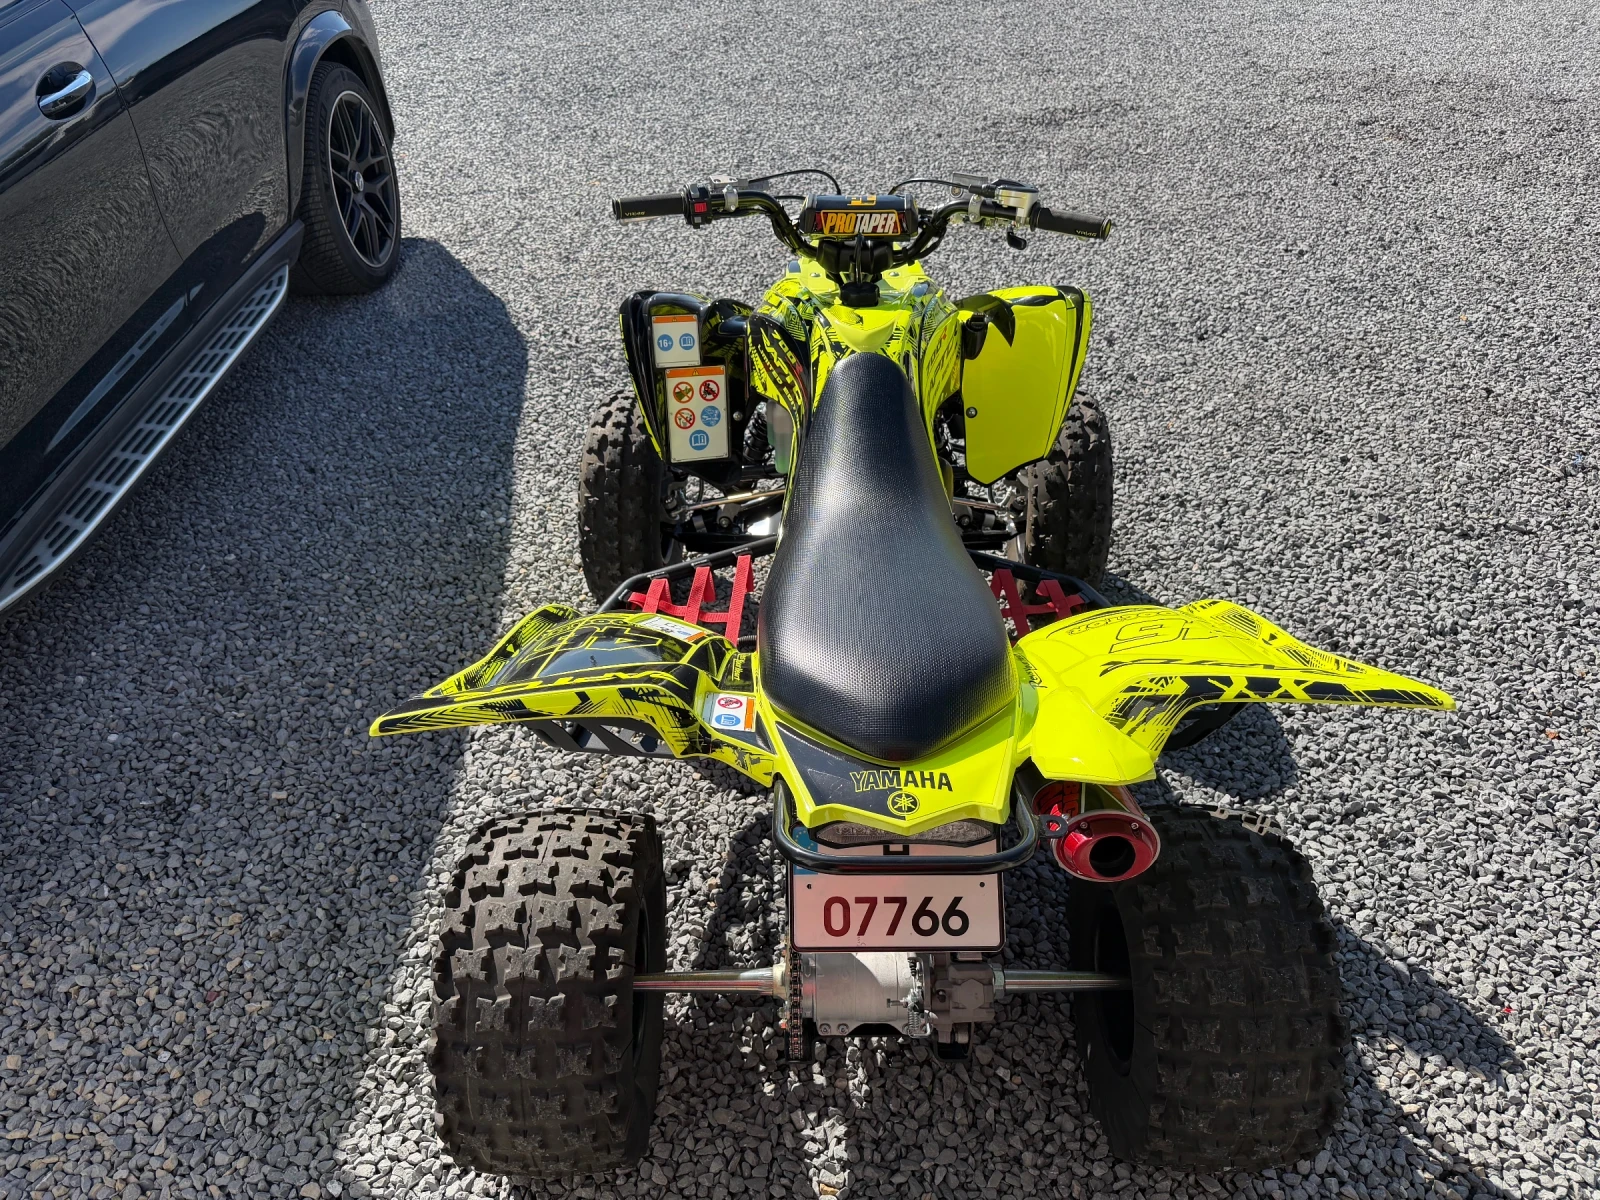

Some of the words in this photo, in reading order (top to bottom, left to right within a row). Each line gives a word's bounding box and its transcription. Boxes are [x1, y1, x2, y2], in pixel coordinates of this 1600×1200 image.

[825, 213, 896, 233] PROTAPER
[658, 339, 673, 348] 16+
[849, 769, 953, 792] YAMAHA
[823, 896, 970, 937] 07766
